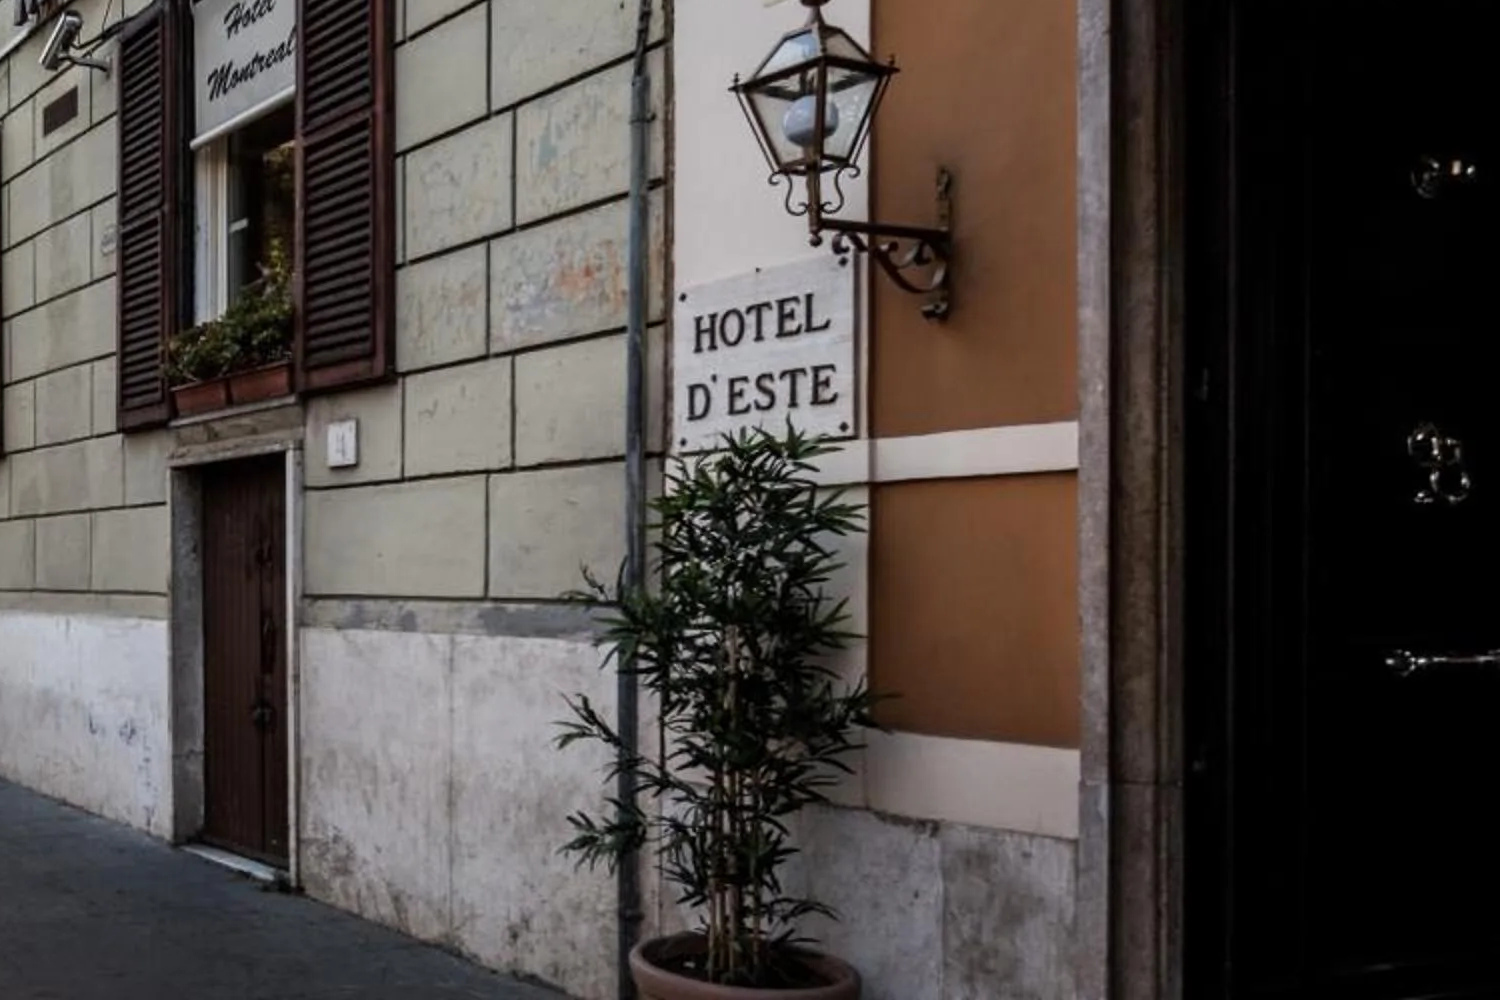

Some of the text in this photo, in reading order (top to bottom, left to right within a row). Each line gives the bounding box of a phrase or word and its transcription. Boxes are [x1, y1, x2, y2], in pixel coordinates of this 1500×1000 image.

[207, 23, 297, 102] Montreal
[692, 292, 832, 354] HOTEL
[686, 363, 840, 422] D'ESTE
